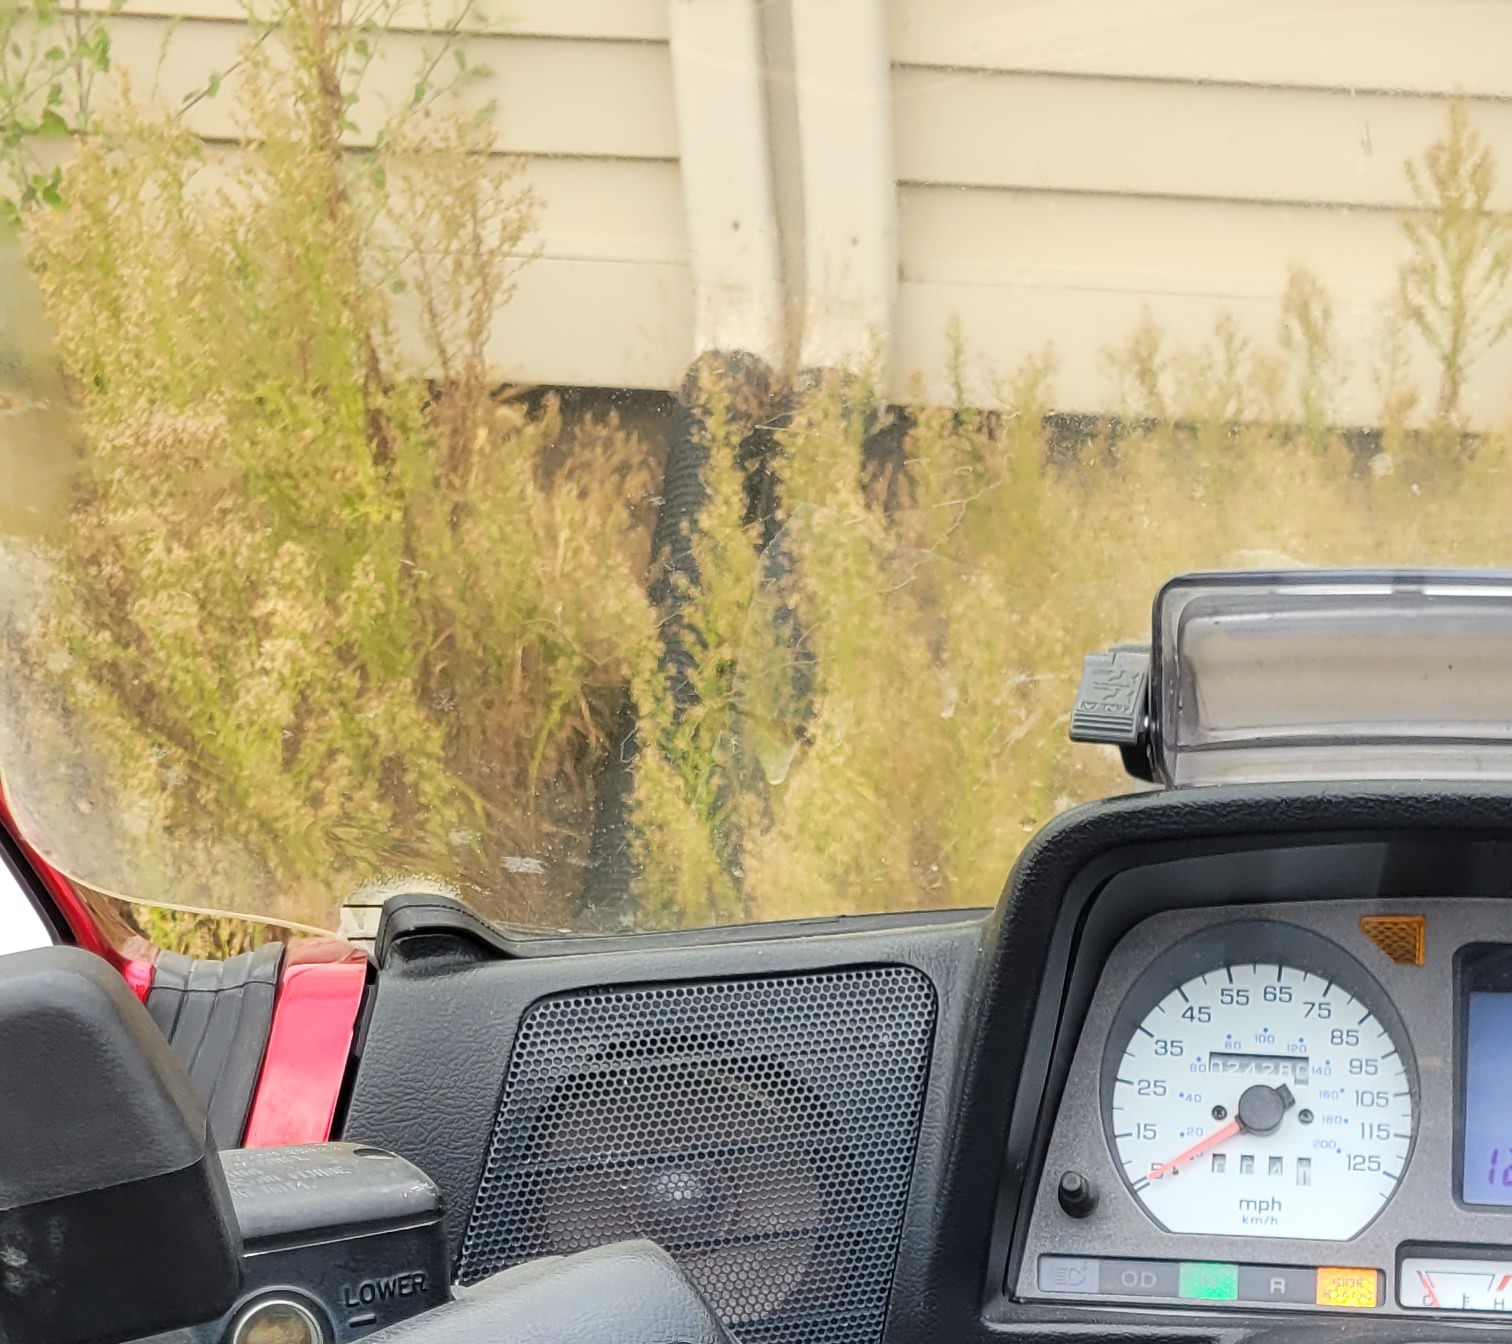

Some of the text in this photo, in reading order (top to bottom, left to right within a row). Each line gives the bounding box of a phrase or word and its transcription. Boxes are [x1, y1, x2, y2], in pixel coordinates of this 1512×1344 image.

[1220, 988, 1249, 1006] 55
[1263, 986, 1292, 1003] 65
[1181, 1006, 1212, 1023] 45
[1303, 1002, 1332, 1019] 75
[1254, 1033, 1275, 1045] 100
[1330, 1029, 1359, 1047] 85
[1154, 1040, 1184, 1057] 35
[1349, 1058, 1378, 1076] 95
[1137, 1080, 1167, 1097] 25
[1354, 1090, 1389, 1107] 105
[1136, 1123, 1157, 1140] 15
[1360, 1123, 1391, 1140] 115
[1347, 1154, 1381, 1173] 125
[1239, 1196, 1282, 1213] mph
[1242, 1214, 1278, 1226] km/h
[1121, 1271, 1157, 1289] OD
[343, 1270, 428, 1308] LOWER
[1493, 1298, 1505, 1310] H
